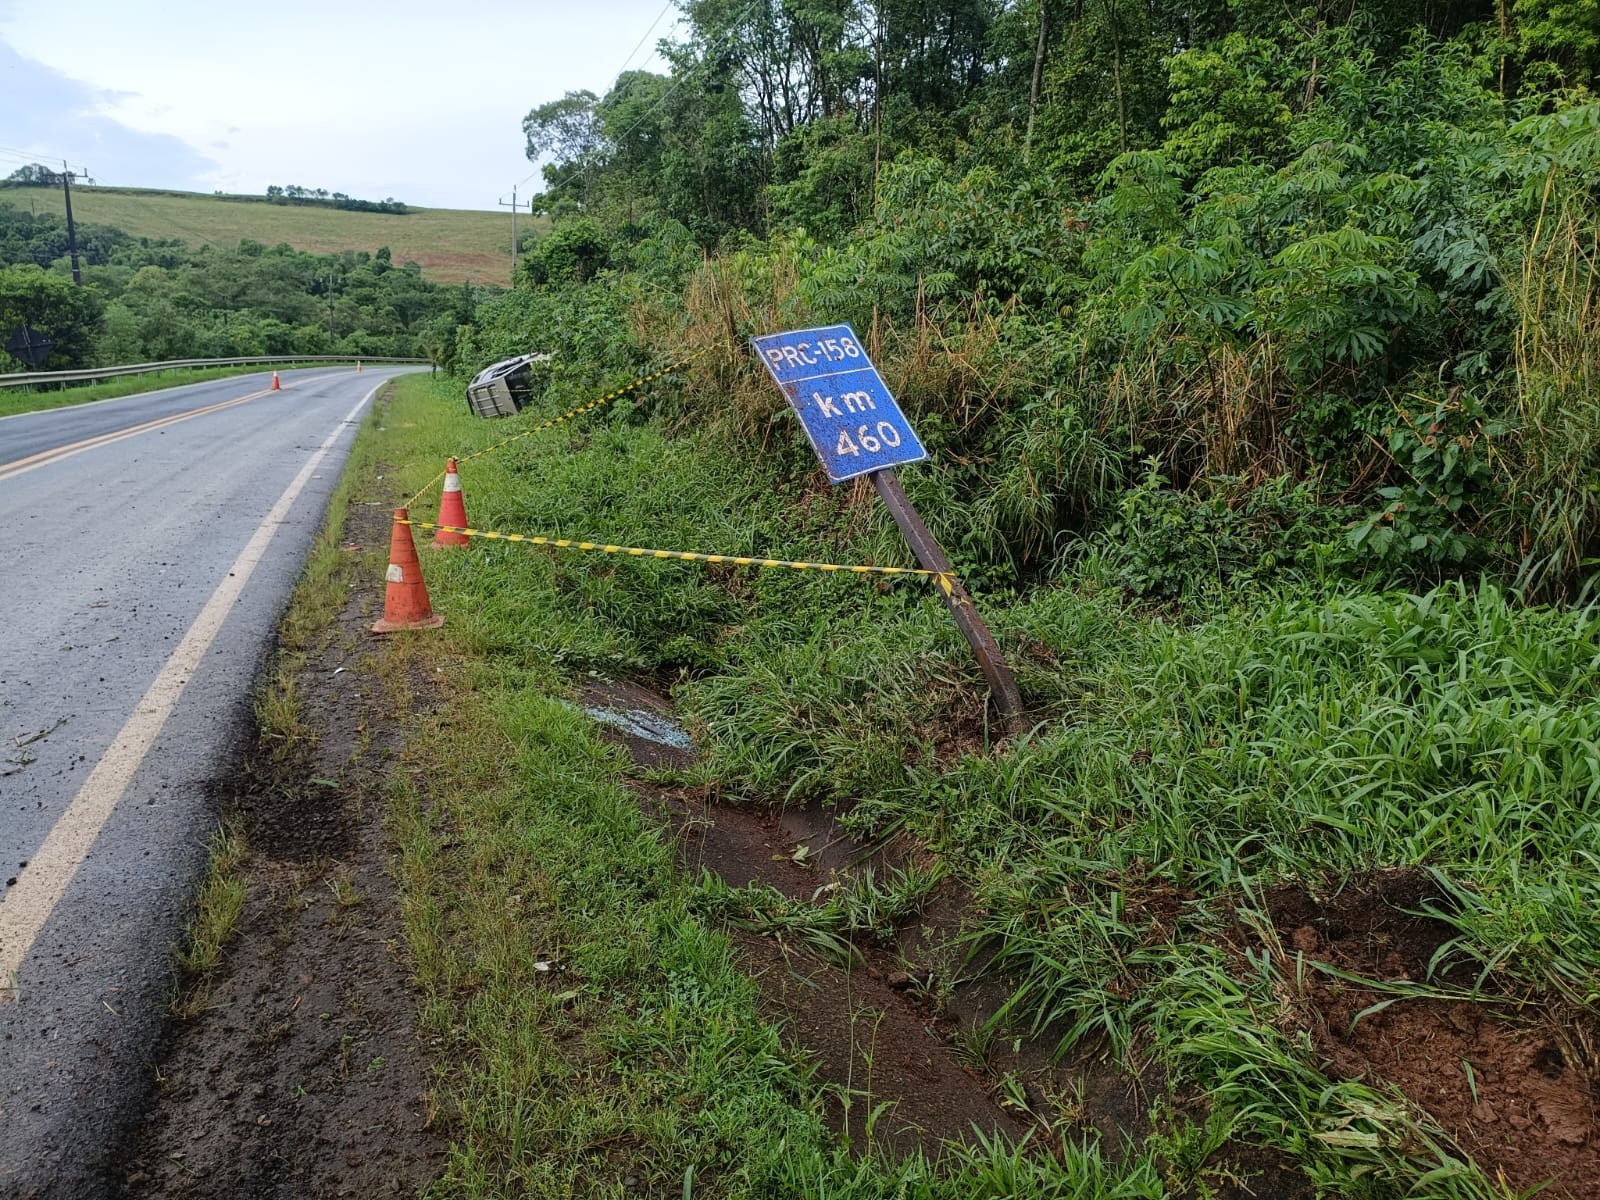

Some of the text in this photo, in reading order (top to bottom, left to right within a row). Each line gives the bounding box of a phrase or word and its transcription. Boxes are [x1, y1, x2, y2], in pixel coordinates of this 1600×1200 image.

[766, 337, 860, 371] PRC-158
[812, 390, 876, 418] km
[836, 421, 901, 457] 460
